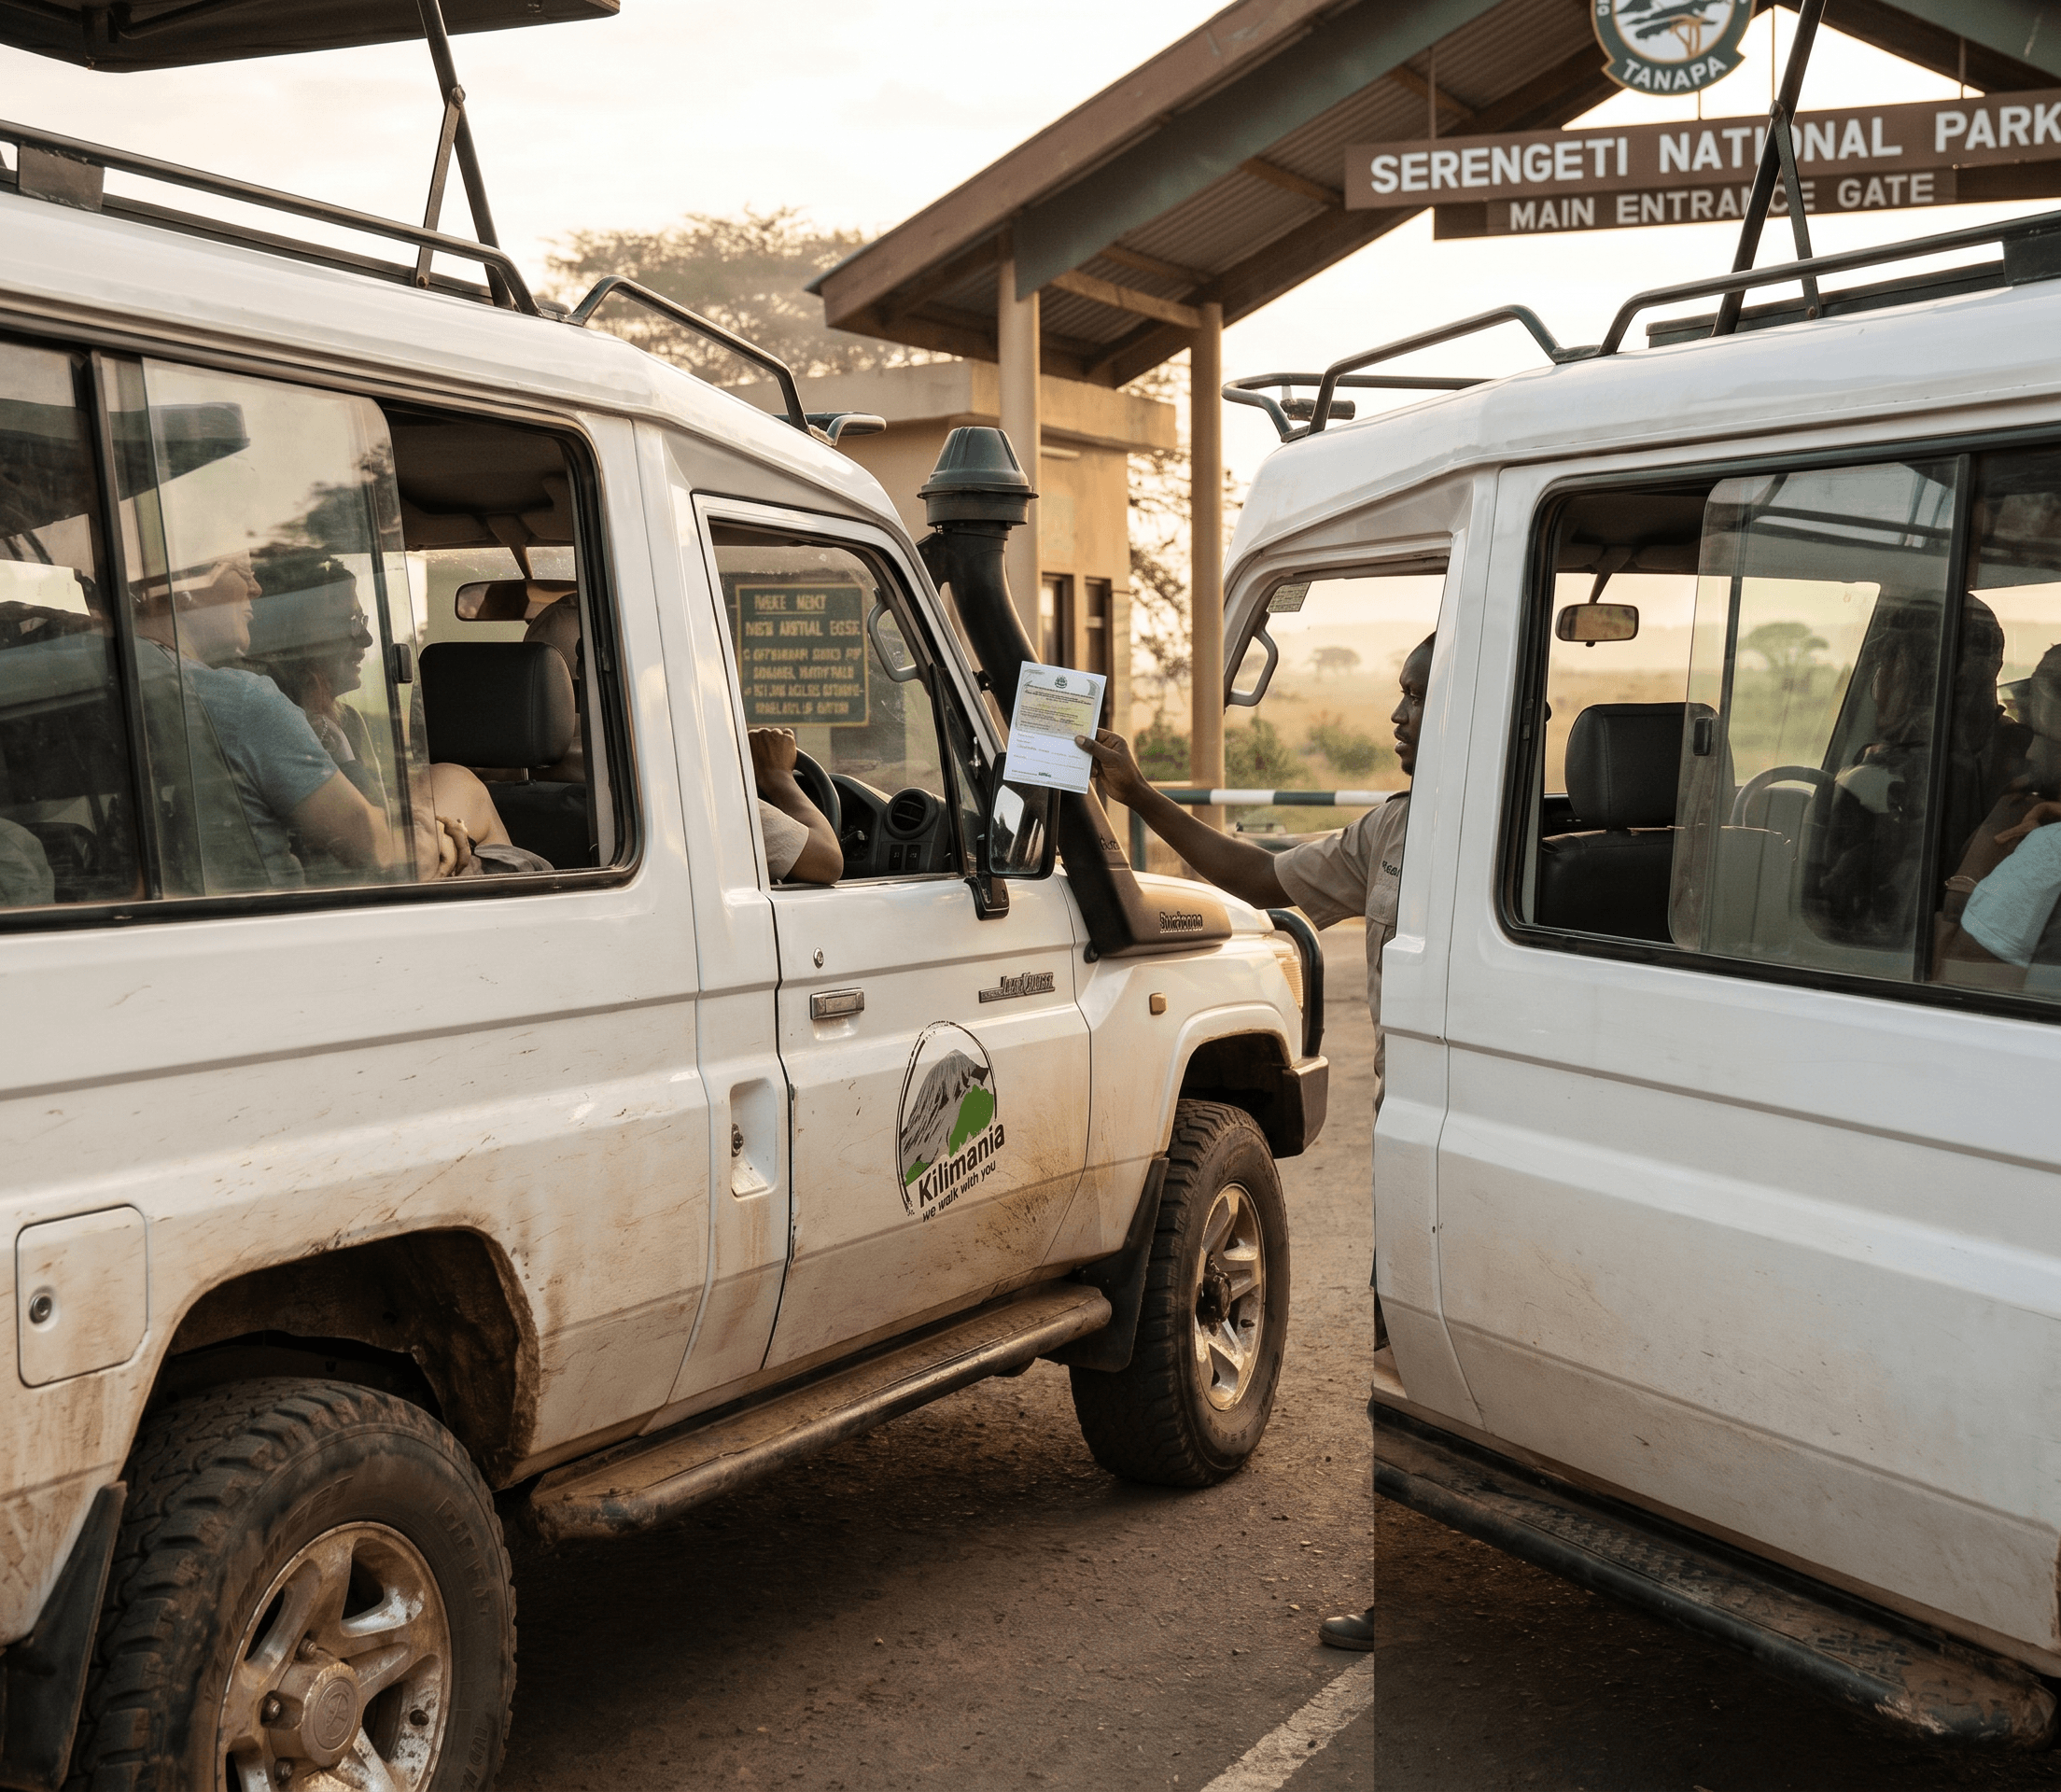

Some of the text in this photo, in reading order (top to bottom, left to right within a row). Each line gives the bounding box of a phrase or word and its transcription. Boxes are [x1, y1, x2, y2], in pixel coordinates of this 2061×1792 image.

[1622, 56, 1728, 91] TANAPA
[1369, 137, 1629, 194] SERENGETI
[1934, 102, 2061, 153] PARK
[1509, 197, 1595, 231] MAIN
[1837, 174, 1935, 209] GATE
[918, 1124, 1005, 1209] Kilimania
[922, 1160, 996, 1223] we walk with you
